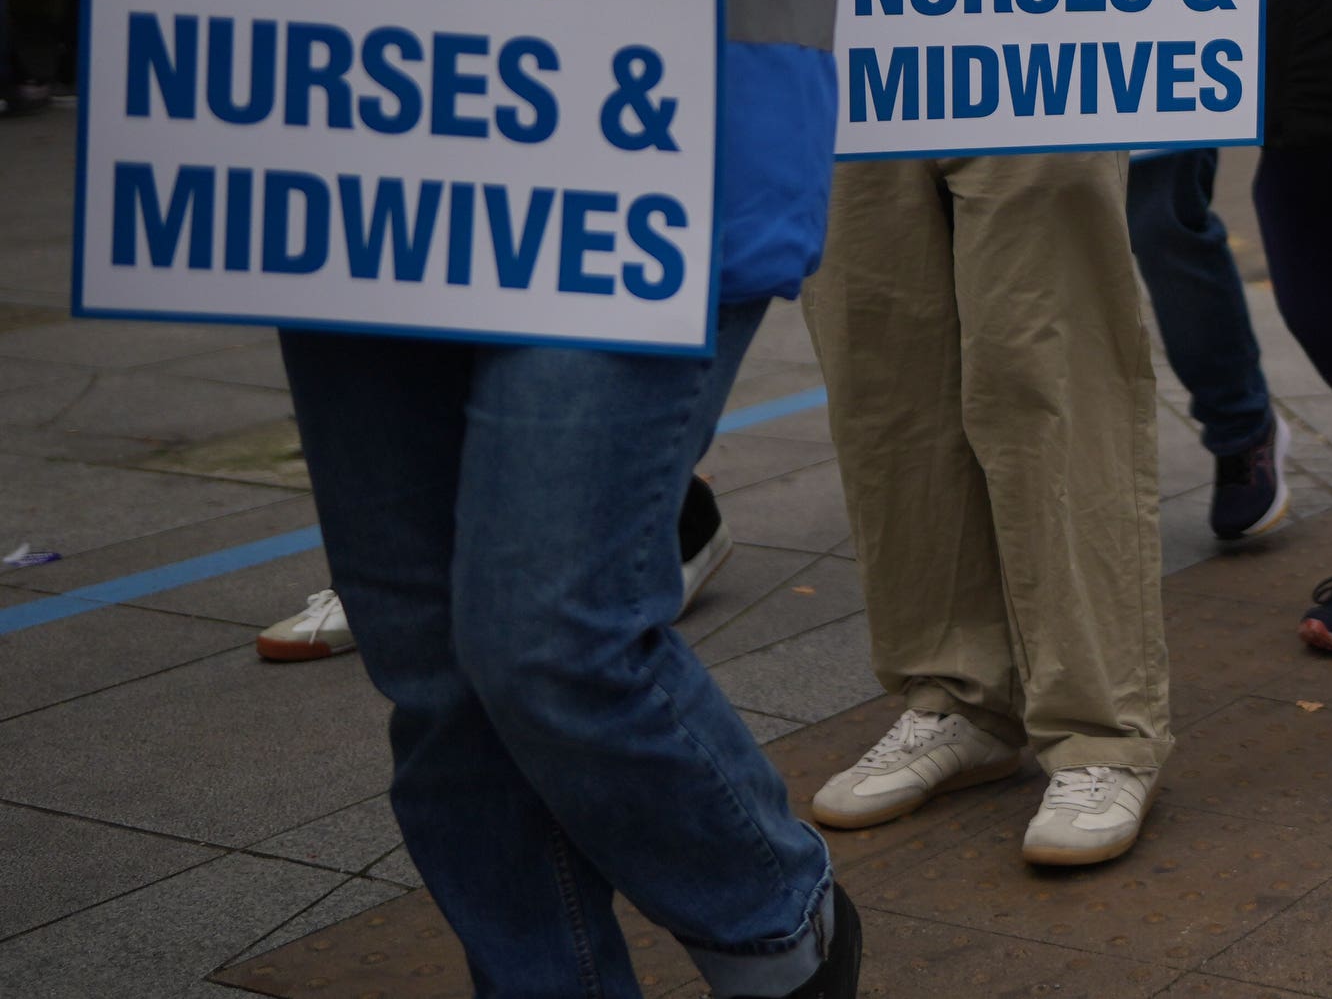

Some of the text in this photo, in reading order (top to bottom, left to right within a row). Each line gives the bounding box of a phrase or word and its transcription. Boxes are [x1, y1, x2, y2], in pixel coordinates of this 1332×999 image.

[124, 10, 681, 153] NURSES &
[848, 38, 1244, 123] MIDWIVES
[109, 159, 689, 302] MIDWIVES
